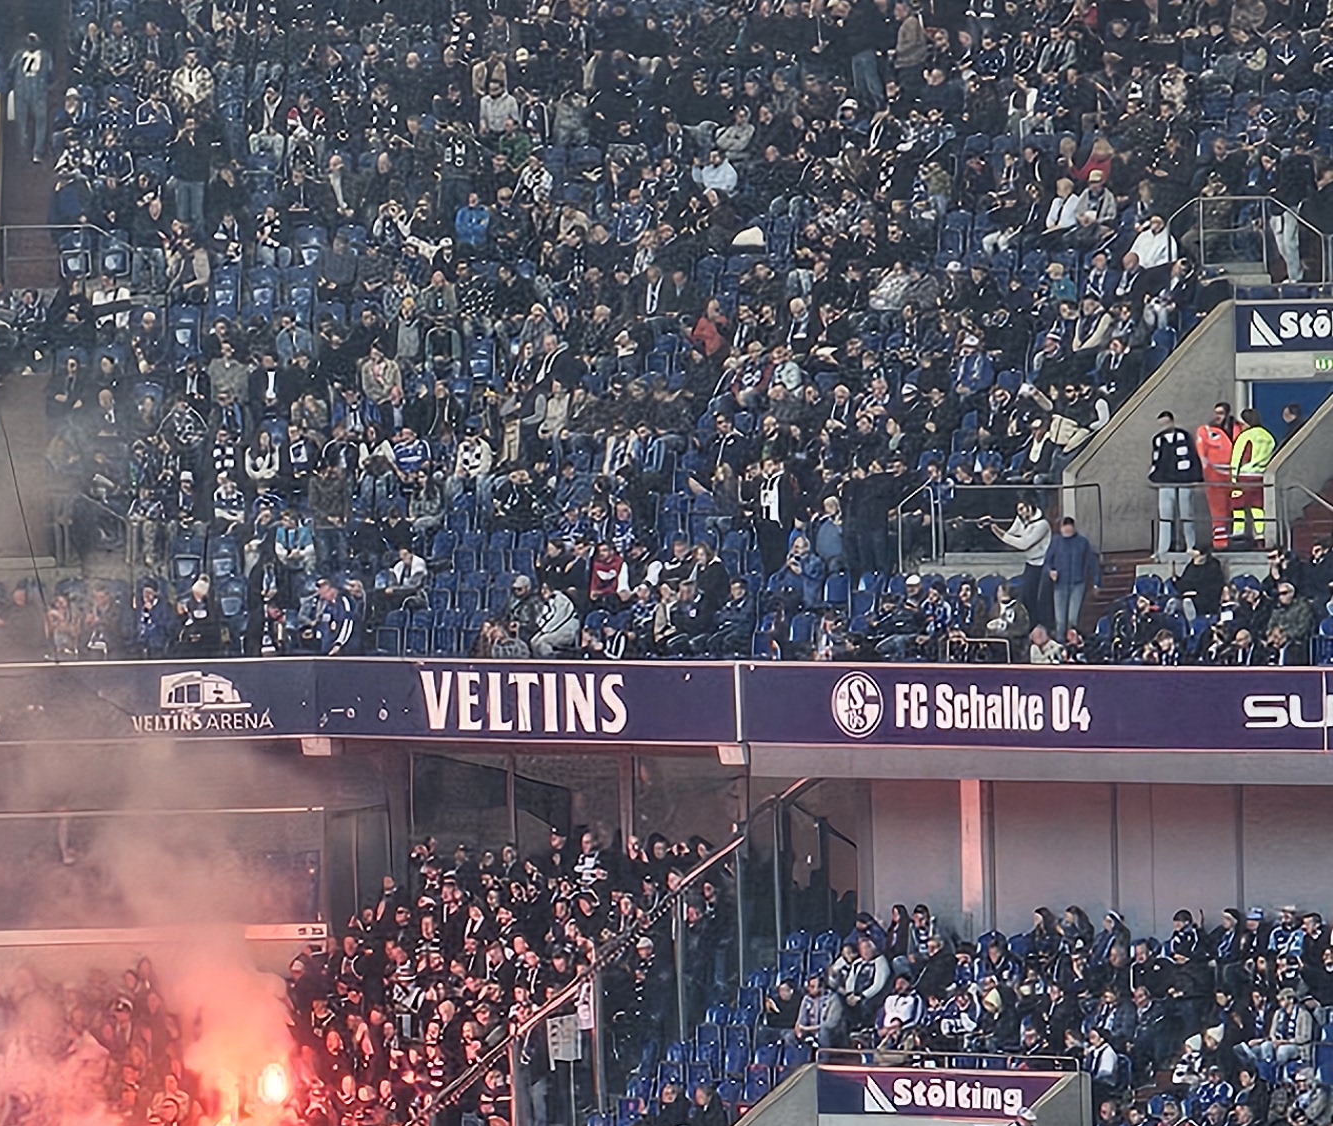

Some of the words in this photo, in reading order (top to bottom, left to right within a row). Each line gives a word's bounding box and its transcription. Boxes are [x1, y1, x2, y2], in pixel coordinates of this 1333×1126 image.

[1279, 309, 1333, 339] Stö
[132, 712, 203, 732] VELTINS
[206, 711, 275, 731] ARENA
[419, 671, 628, 734] VELTINS
[894, 683, 929, 729] FC
[935, 683, 1044, 731] Schalke
[1051, 685, 1092, 732] 04
[893, 1078, 1023, 1117] Stölting
